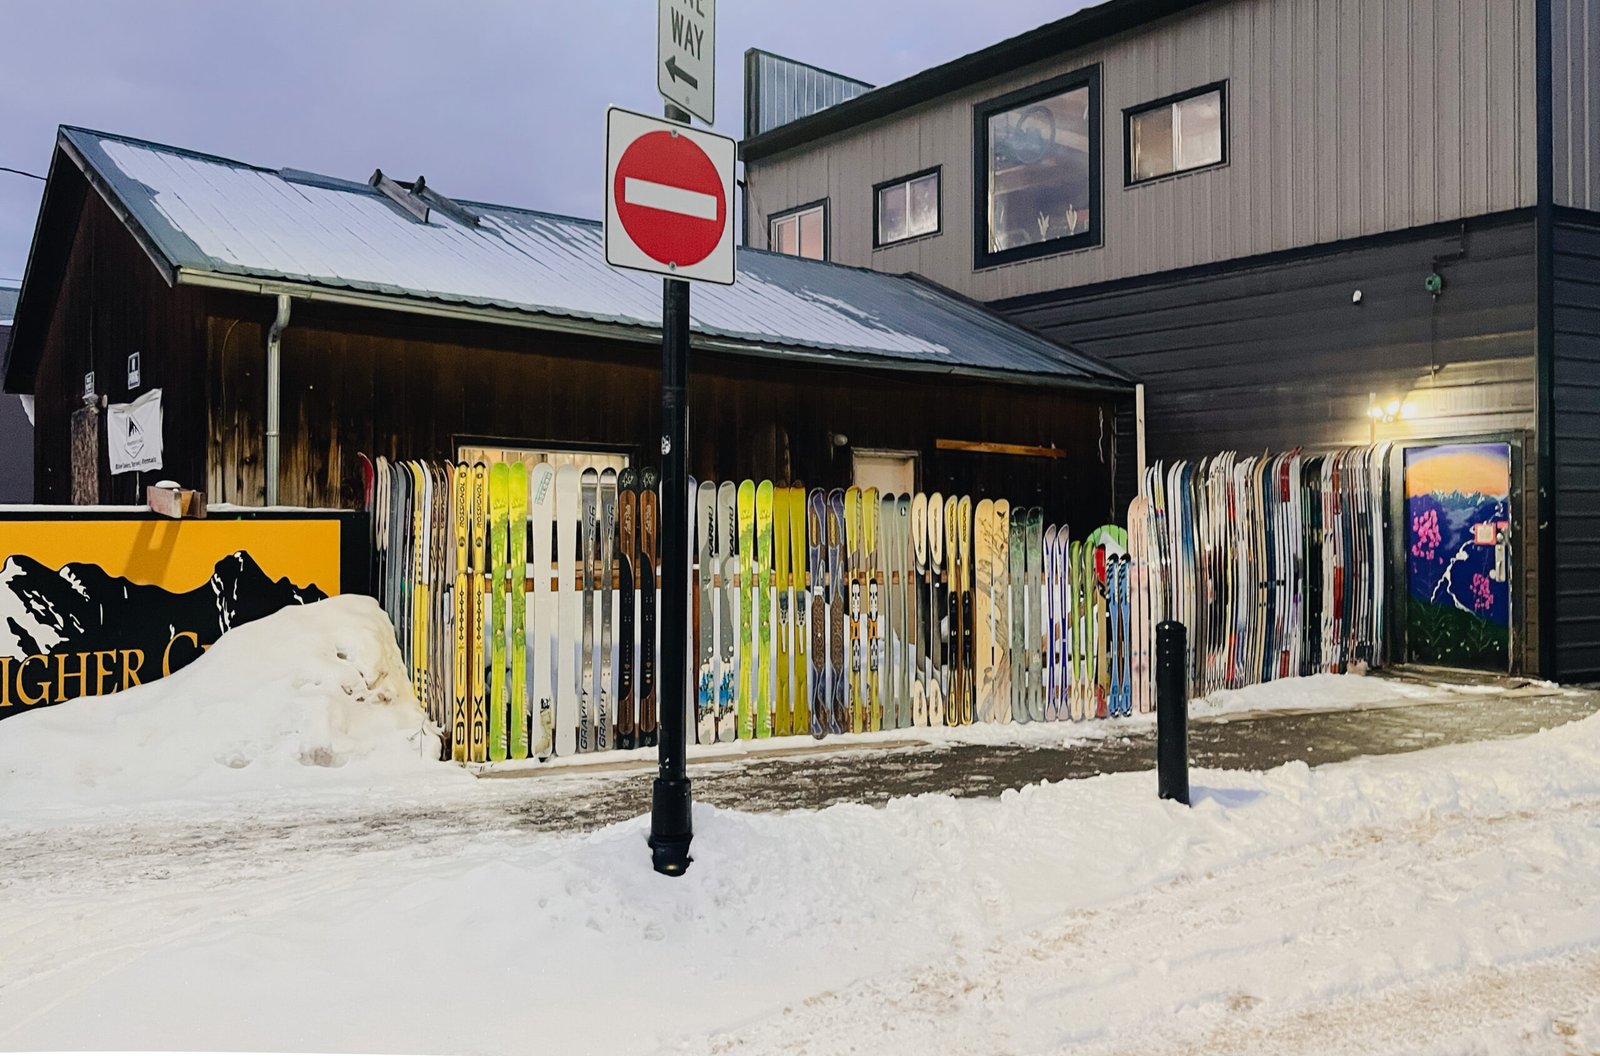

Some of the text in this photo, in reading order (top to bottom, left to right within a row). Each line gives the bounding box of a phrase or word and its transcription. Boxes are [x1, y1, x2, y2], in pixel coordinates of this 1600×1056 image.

[671, 6, 704, 61] WAY
[0, 648, 145, 706] IGHER
[598, 687, 607, 748] GRAVITY
